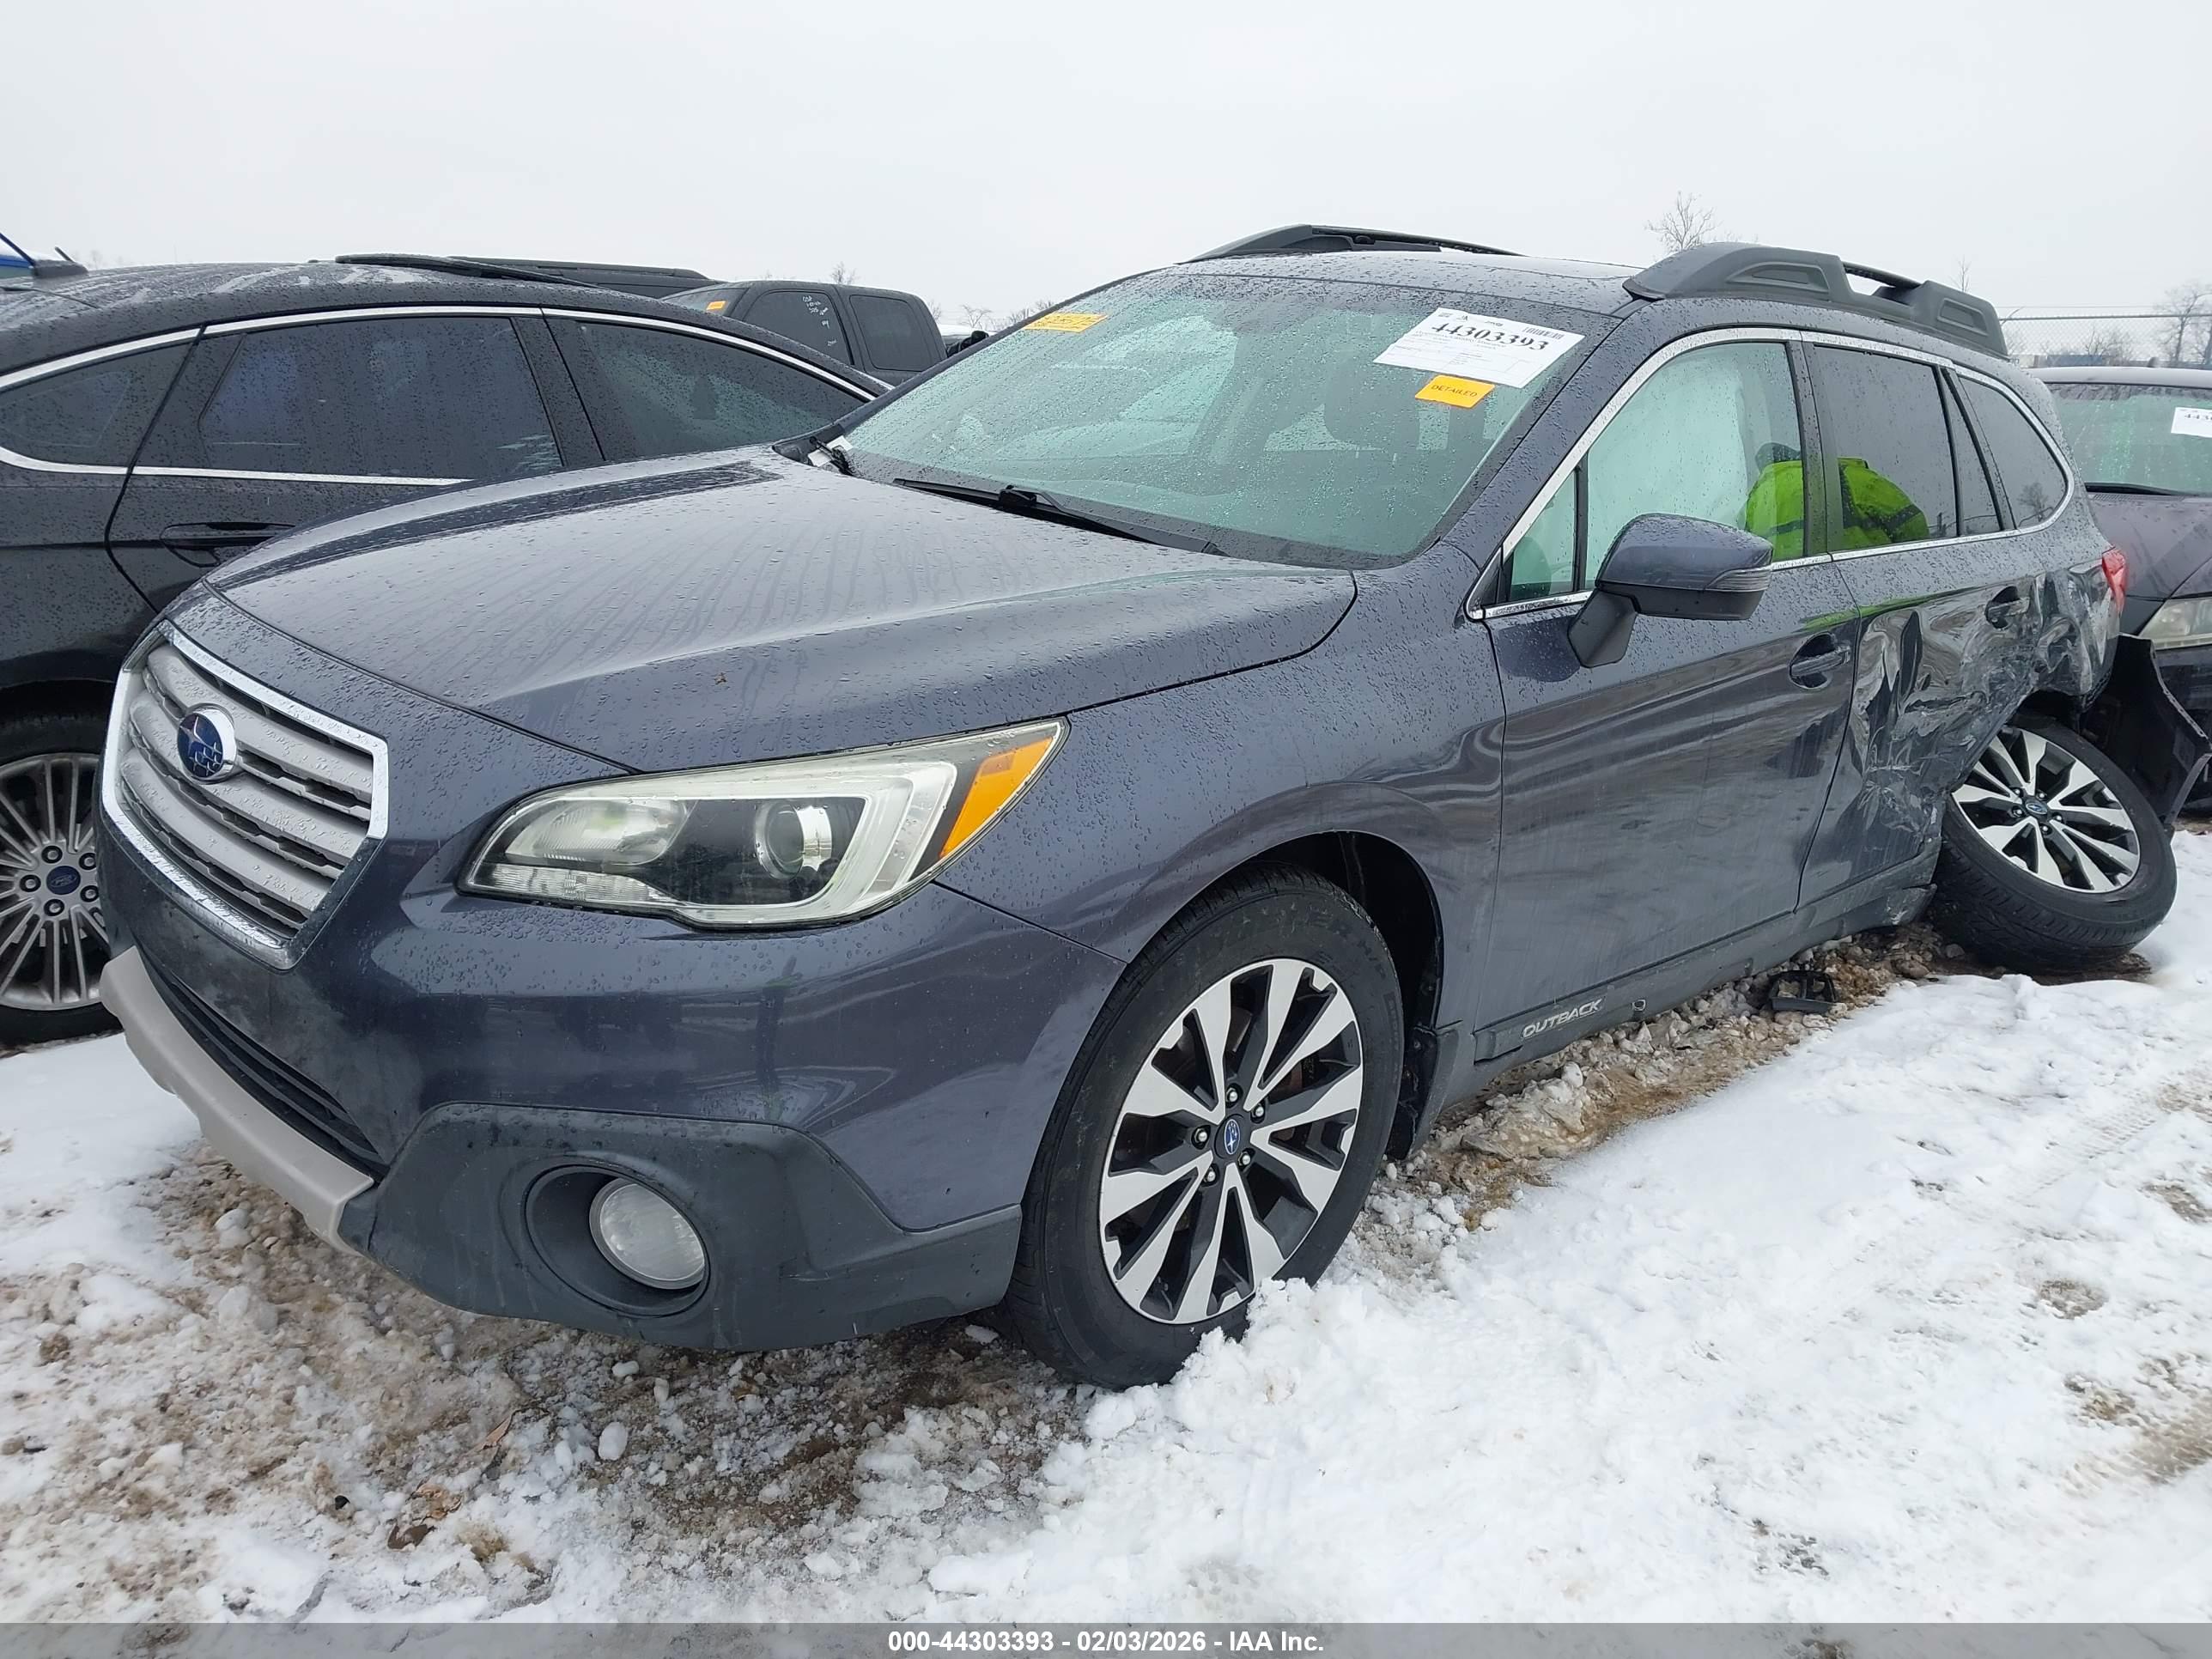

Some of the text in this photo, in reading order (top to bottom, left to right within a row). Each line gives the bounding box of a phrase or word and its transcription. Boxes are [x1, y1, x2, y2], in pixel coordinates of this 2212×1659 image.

[1431, 323, 1549, 350] 44303393
[1431, 384, 1478, 398] DETAILED
[1522, 999, 1603, 1038] OUTBACK
